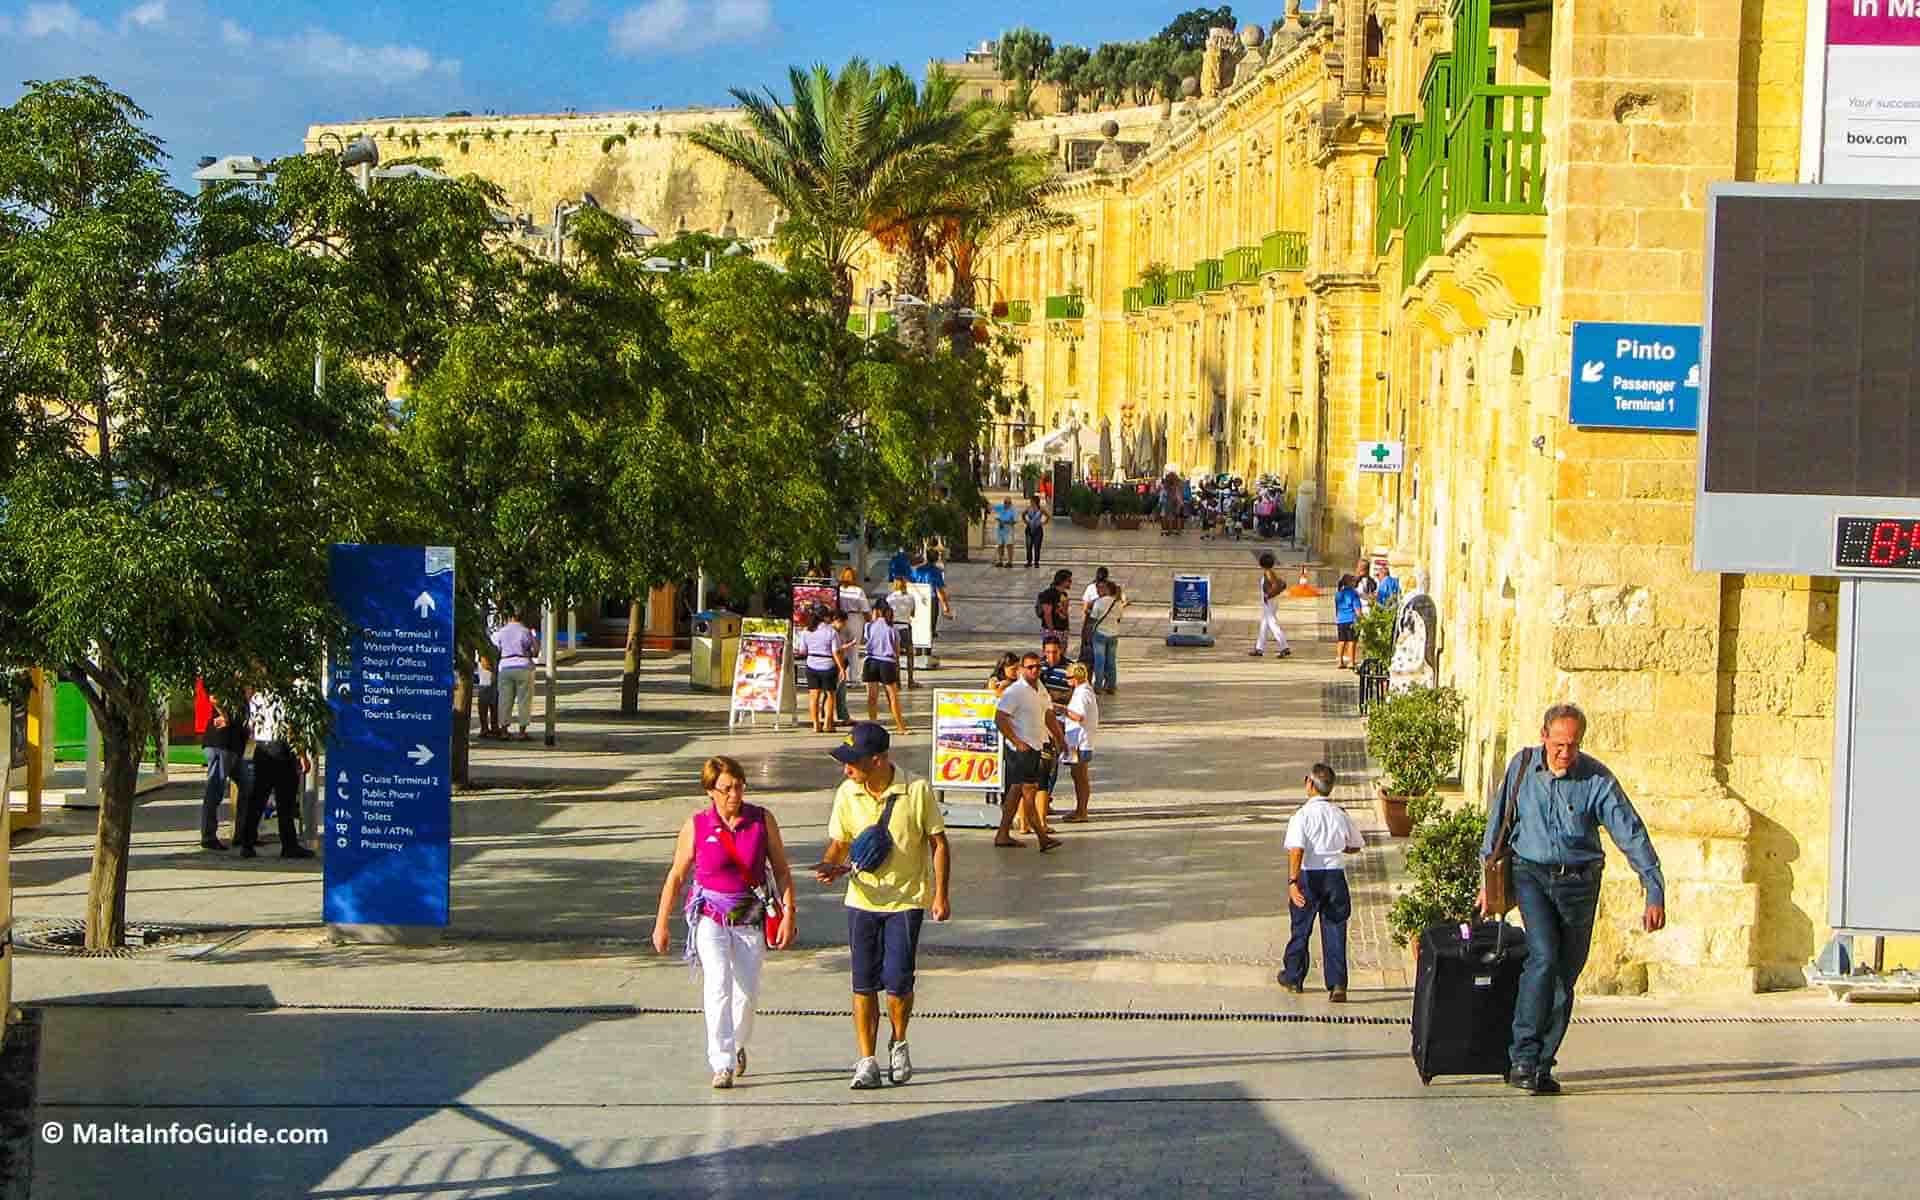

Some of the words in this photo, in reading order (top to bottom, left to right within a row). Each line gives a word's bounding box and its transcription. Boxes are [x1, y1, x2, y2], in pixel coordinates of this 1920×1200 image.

[1847, 131, 1908, 145] bov.com
[1616, 338, 1676, 360] Pinto
[1613, 375, 1677, 394] Passenger
[1614, 396, 1665, 412] Terminal
[1667, 397, 1675, 412] 1
[394, 629, 432, 640] Terminal
[363, 641, 414, 653] Waterfront
[363, 656, 389, 667] Shops
[396, 657, 427, 668] Offices
[385, 671, 434, 681] Restaurants
[363, 685, 394, 695] Tourist
[396, 686, 448, 697] Information
[363, 695, 390, 705] Office
[363, 709, 394, 720] Tourist
[395, 710, 433, 721] Services
[362, 774, 392, 785] Cruise
[393, 775, 430, 785] Terminal
[432, 777, 439, 786] 2
[362, 788, 387, 799] Public
[388, 790, 415, 799] Phone
[362, 798, 395, 808] Internet
[362, 811, 392, 822] Toilets
[361, 826, 382, 835] Bank
[389, 827, 413, 836] ATMs
[361, 840, 403, 851] Pharmacy
